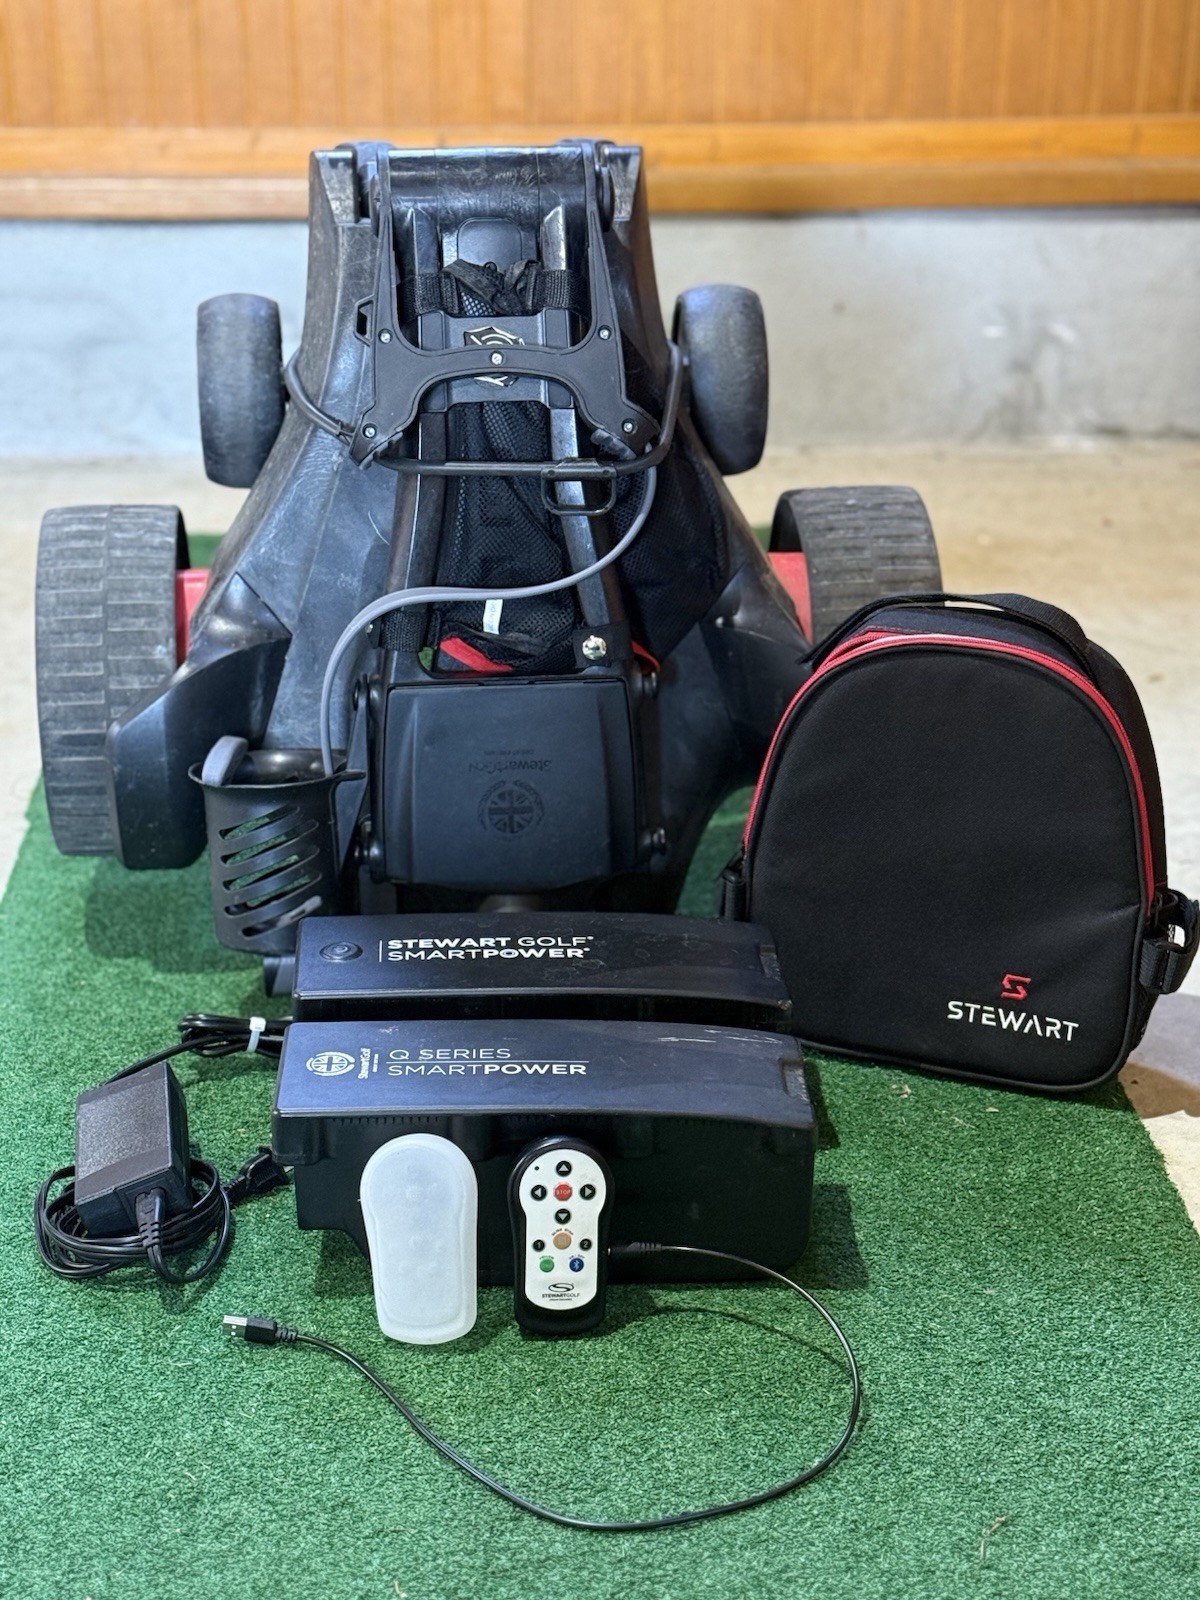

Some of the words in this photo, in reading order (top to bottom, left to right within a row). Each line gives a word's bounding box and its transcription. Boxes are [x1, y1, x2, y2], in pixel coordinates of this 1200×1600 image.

[387, 937, 511, 950] STEWART
[387, 947, 586, 961] SMARTPOWER
[947, 1000, 1079, 1041] STEWART
[389, 1049, 409, 1062] Q
[418, 1048, 511, 1060] SERIES
[387, 1063, 587, 1076] SMARTPOWER
